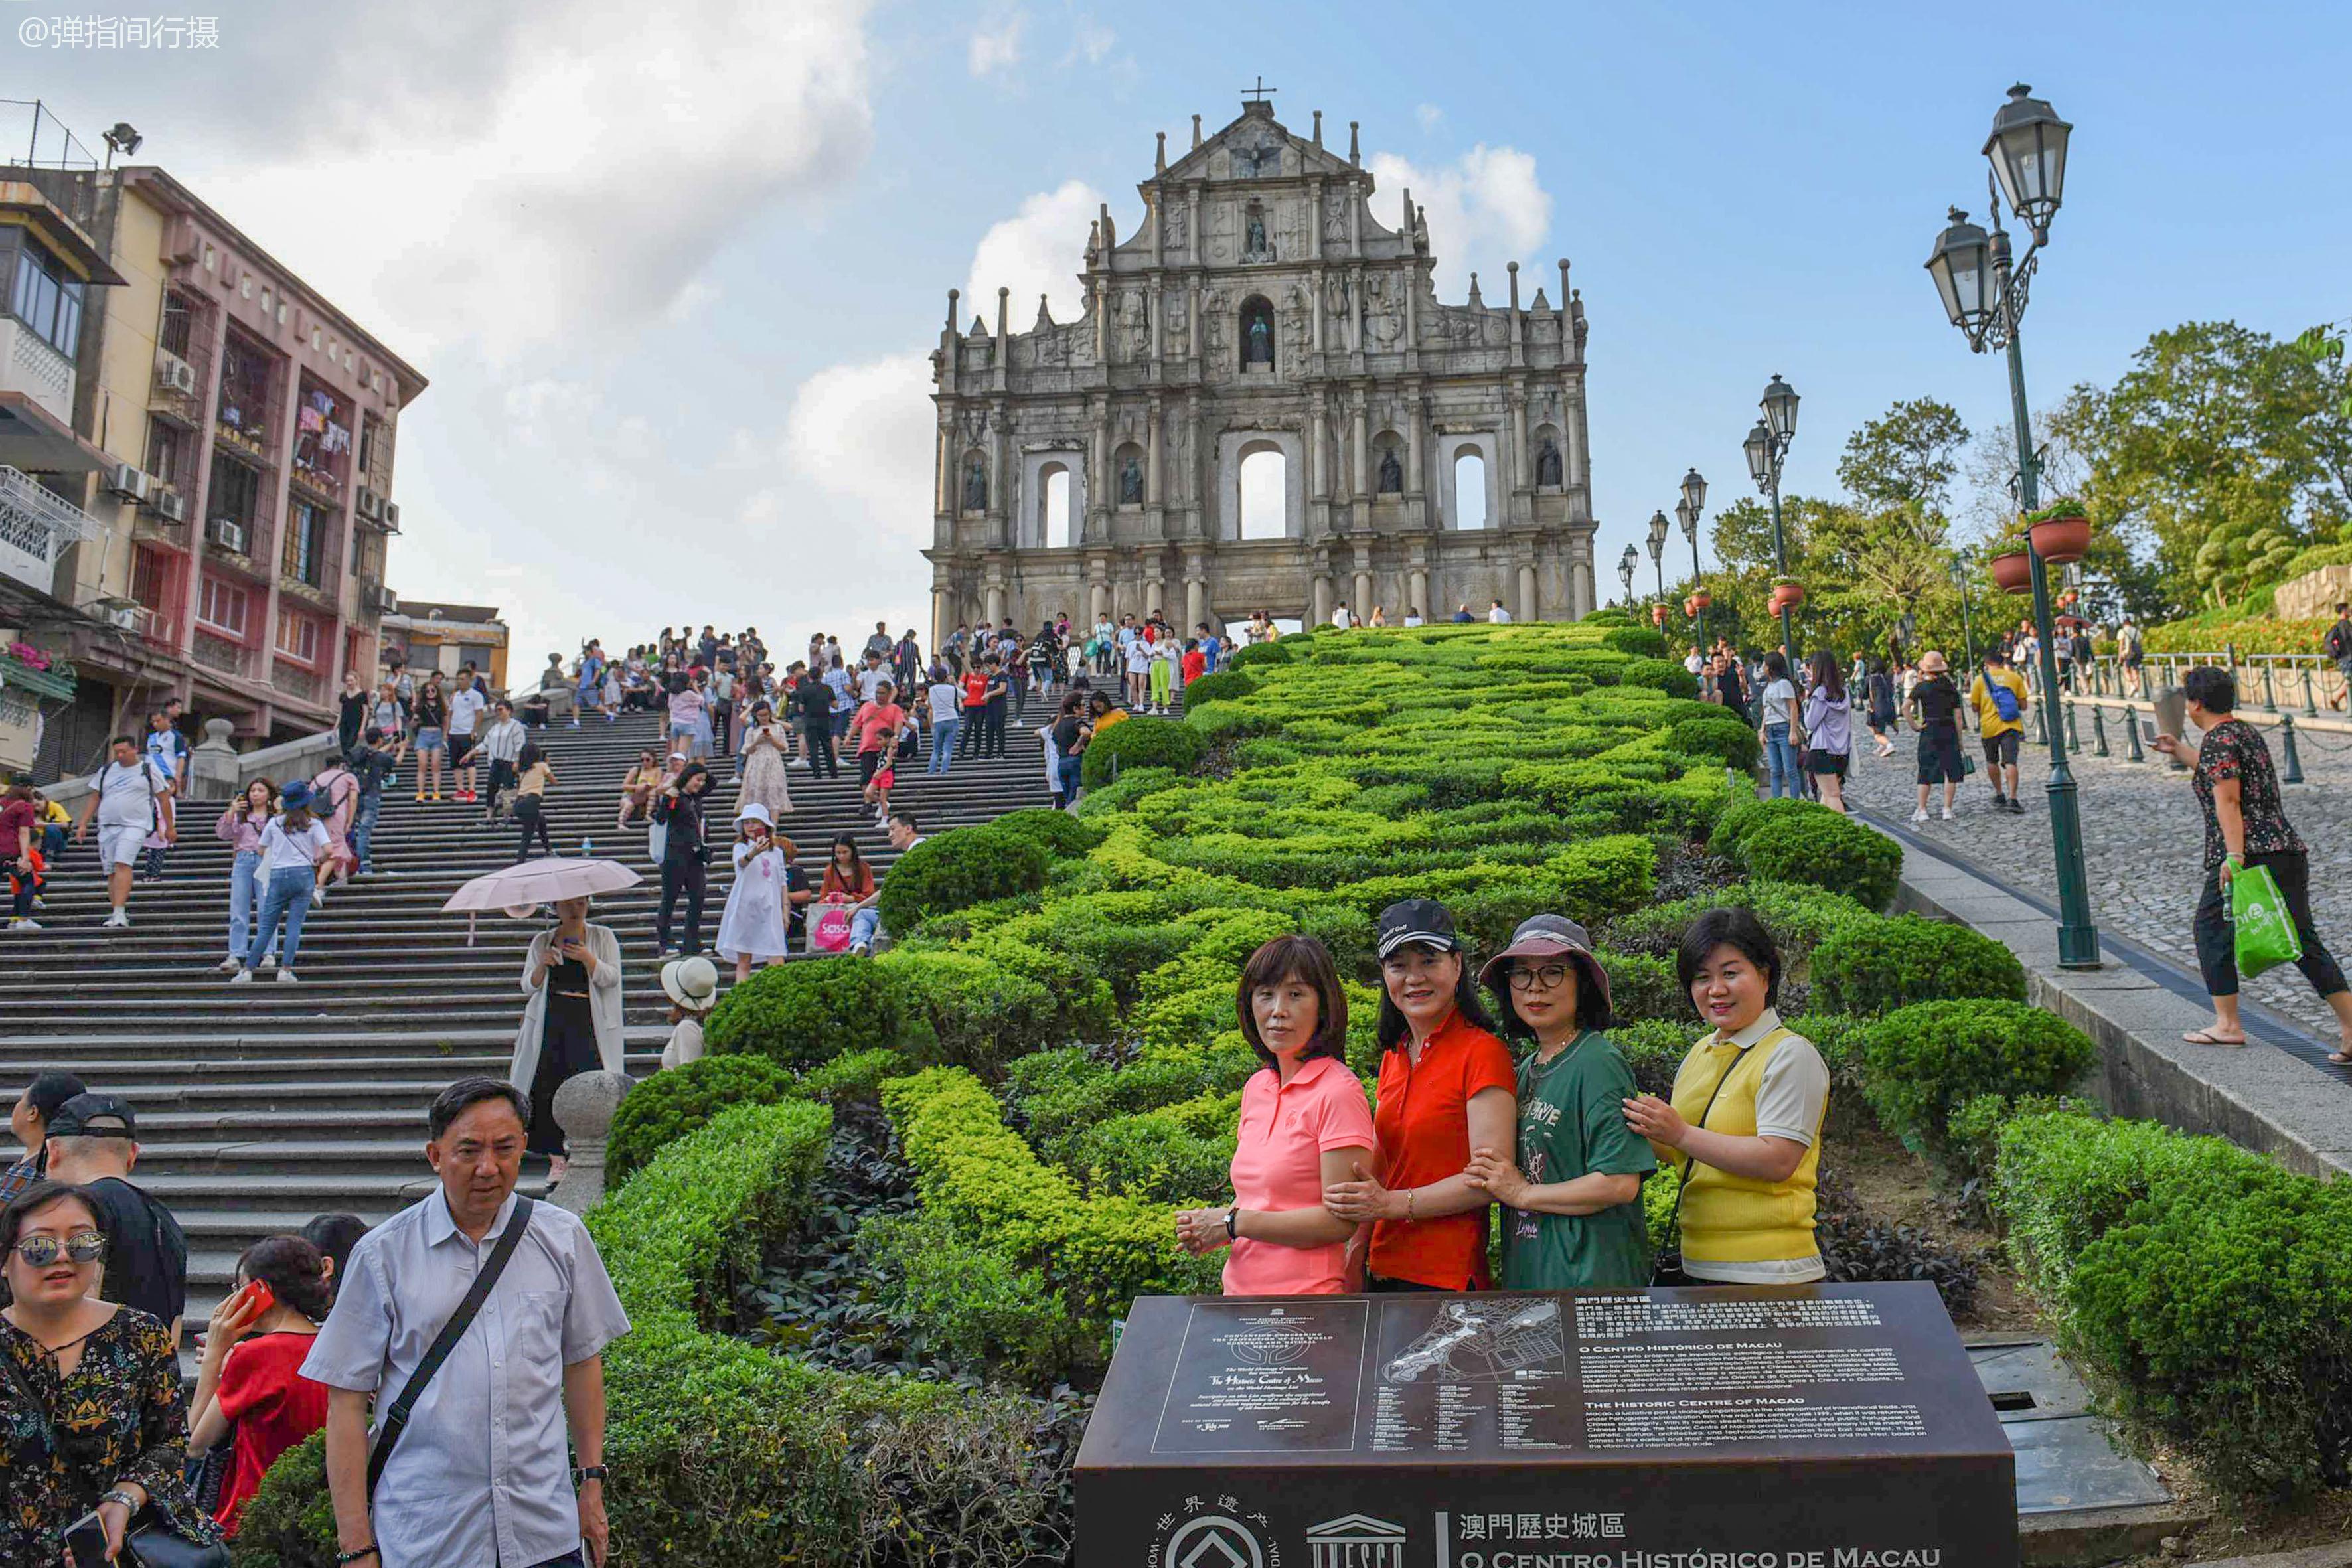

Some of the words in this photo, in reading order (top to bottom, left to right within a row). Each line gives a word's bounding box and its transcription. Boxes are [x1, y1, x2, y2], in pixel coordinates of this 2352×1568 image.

[1208, 1376, 1223, 1385] The
[1225, 1375, 1257, 1384] Historic
[1258, 1375, 1282, 1384] Centre
[1460, 1513, 1626, 1539] 澳門歷史城區
[1461, 1552, 1483, 1568] O
[1492, 1552, 1613, 1568] CENTRO
[1621, 1548, 1778, 1568] HISTÓRICO
[1786, 1551, 1824, 1568] DE
[1833, 1547, 1940, 1568] MACAU
